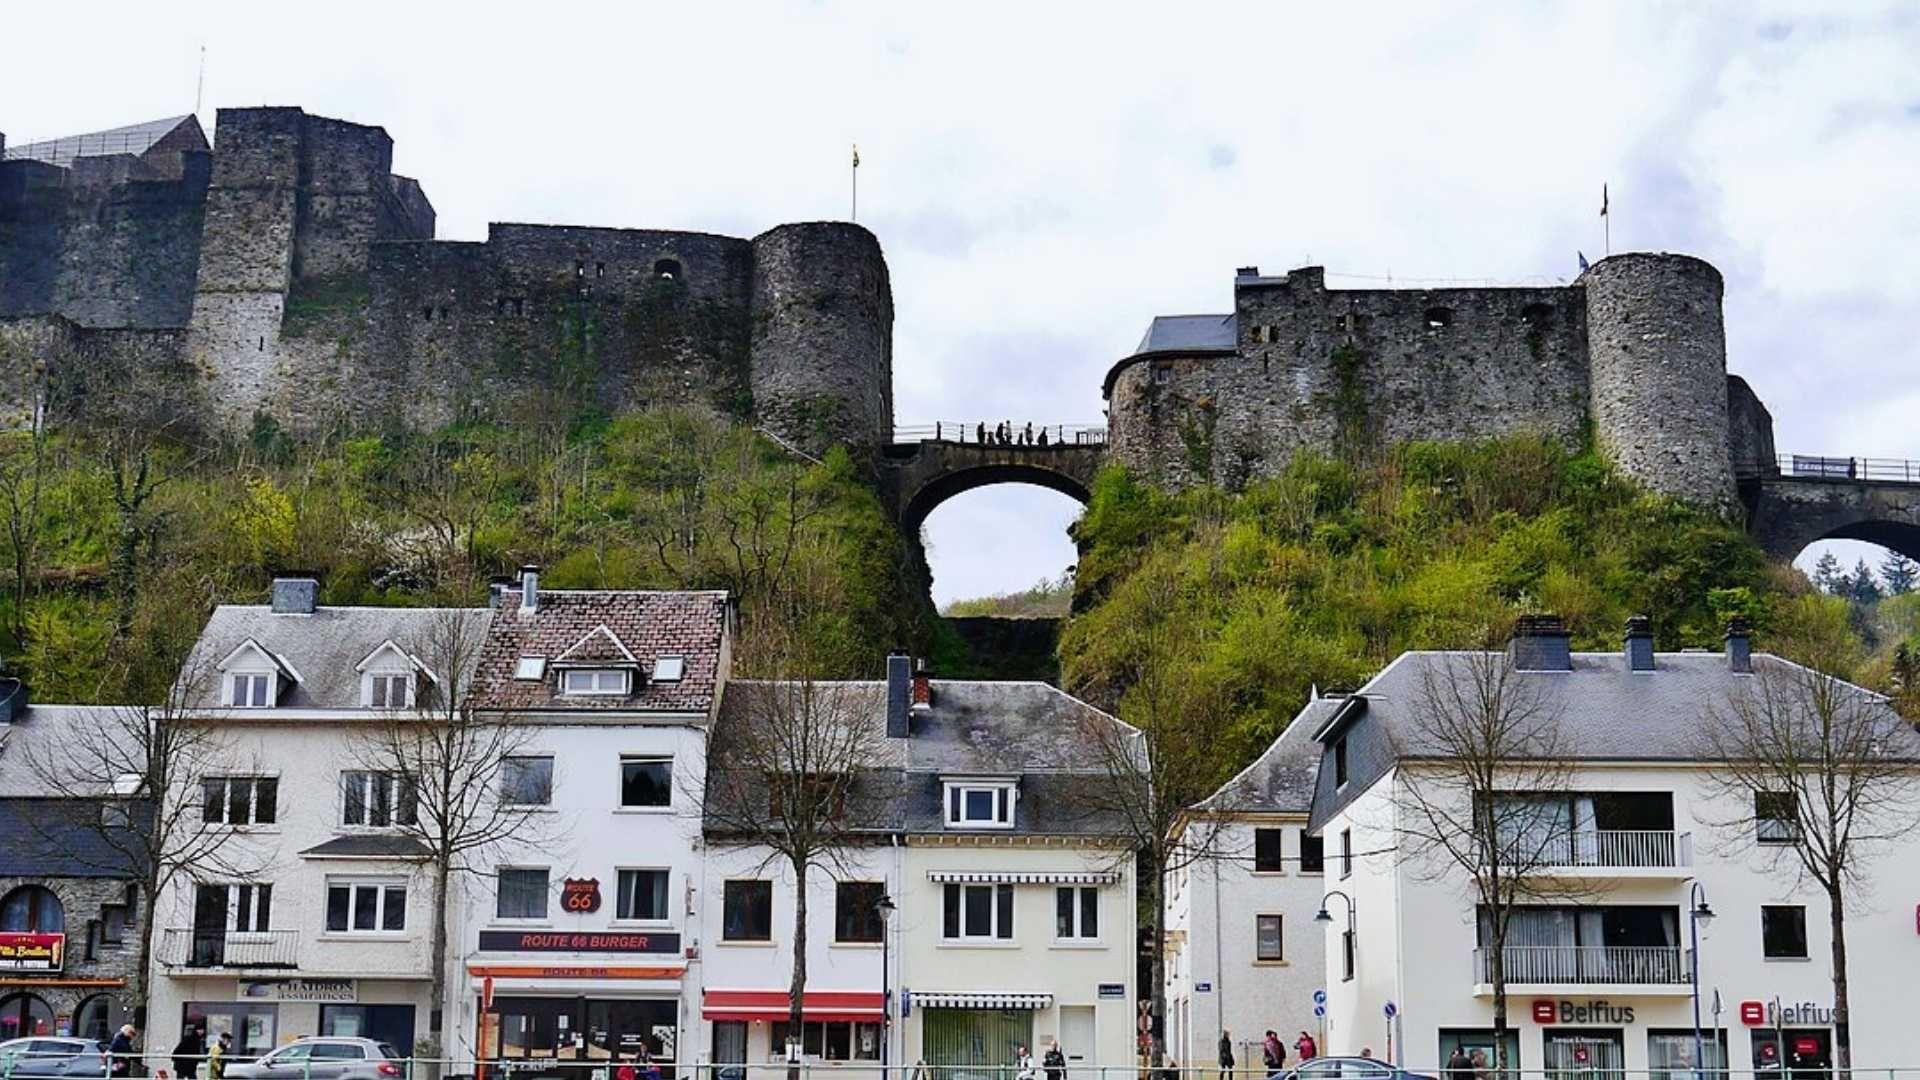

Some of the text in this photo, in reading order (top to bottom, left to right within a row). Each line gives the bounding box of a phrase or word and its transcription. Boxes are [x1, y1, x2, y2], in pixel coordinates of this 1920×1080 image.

[568, 893, 591, 909] 66
[521, 935, 648, 948] ROUTE 66 BURGER
[278, 991, 354, 1000] assurances
[1560, 1000, 1635, 1024] Belfius
